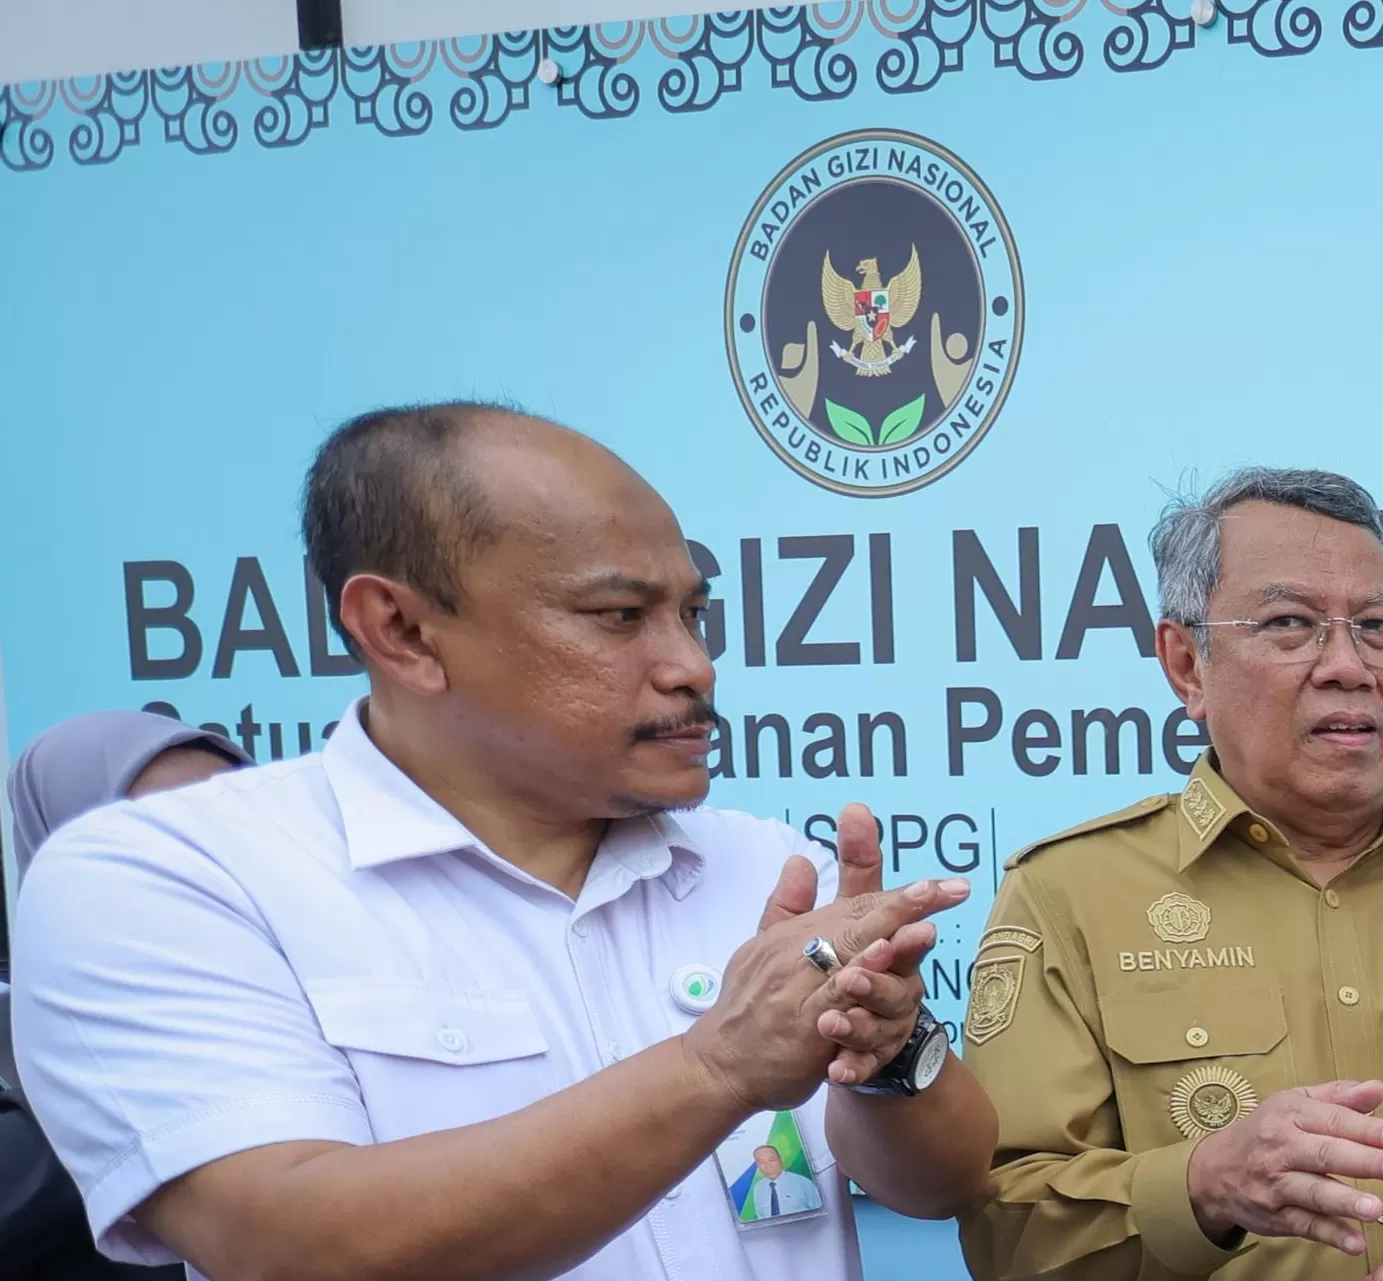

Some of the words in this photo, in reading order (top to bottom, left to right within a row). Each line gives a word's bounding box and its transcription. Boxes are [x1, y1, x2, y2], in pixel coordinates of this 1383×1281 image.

[749, 167, 822, 261] BADAN
[827, 148, 879, 178] GIZI
[887, 148, 999, 259] NASIONAL
[749, 371, 870, 480] REPUBLIK
[881, 338, 1008, 479] INDONESIA
[804, 813, 981, 873] SPG
[1119, 946, 1256, 972] BENYAMIN
